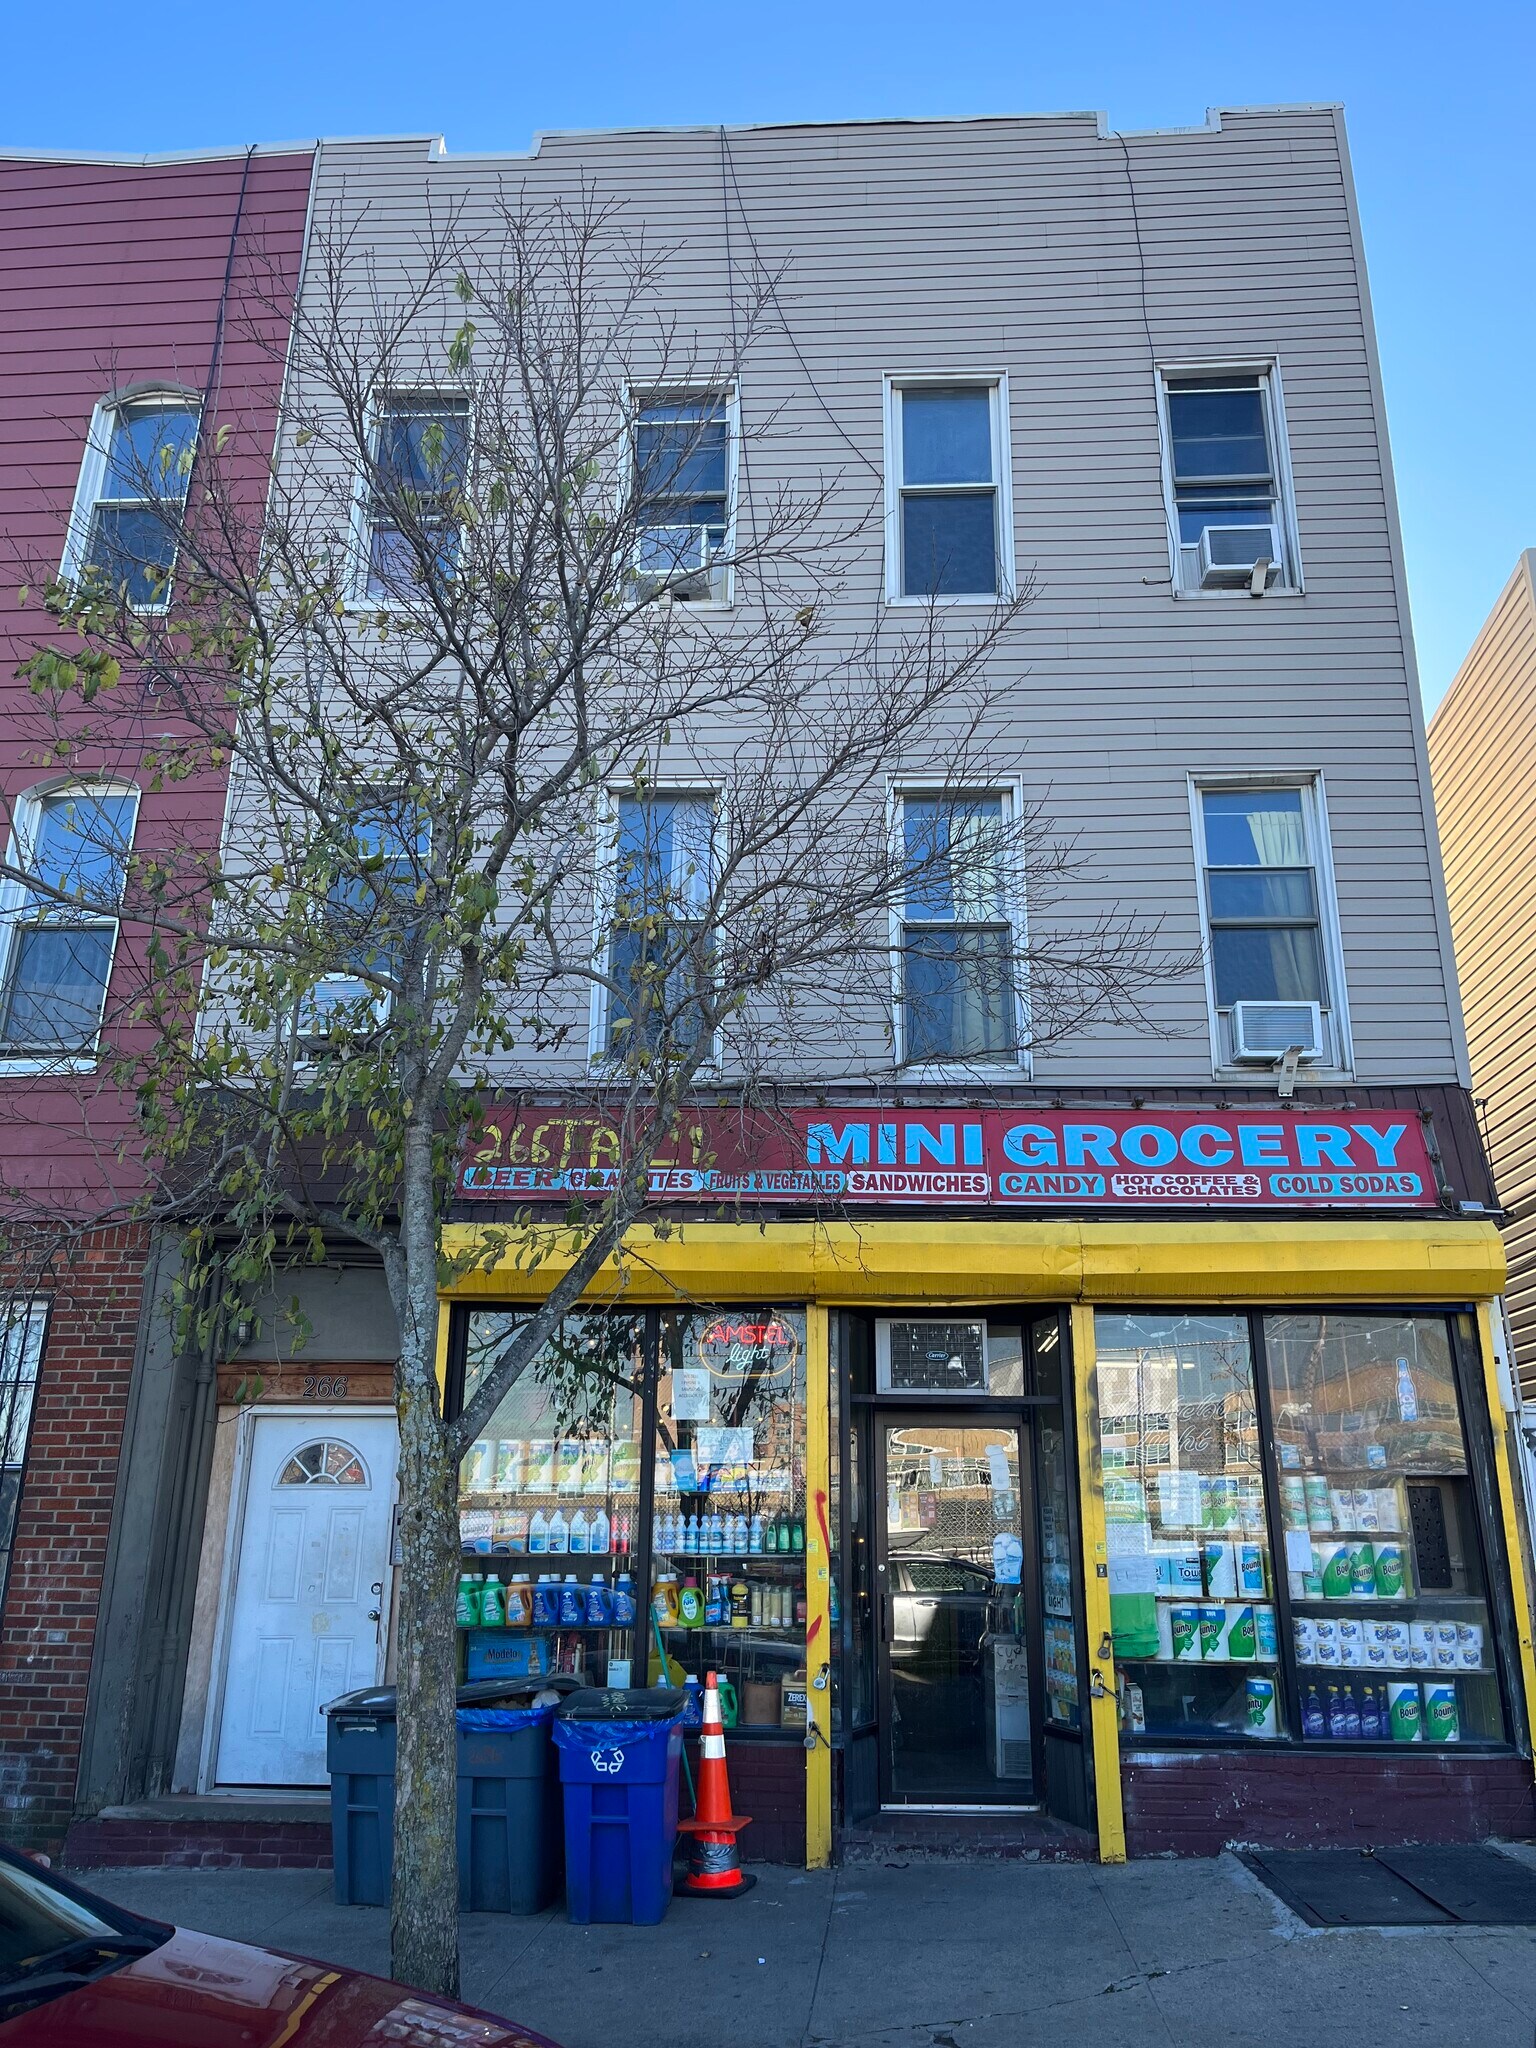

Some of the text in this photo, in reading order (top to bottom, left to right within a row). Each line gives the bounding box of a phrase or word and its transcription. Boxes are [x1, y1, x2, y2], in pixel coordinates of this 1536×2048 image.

[807, 1123, 1408, 1168] MINI GROCERY
[473, 1169, 553, 1187] BEER
[766, 1173, 841, 1191] VEGETABLES
[852, 1173, 986, 1193] SANDWICHES
[1004, 1175, 1099, 1194] CANDY
[1115, 1175, 1259, 1186] HOT COFFEE &
[1277, 1175, 1414, 1194] COLD SODAS
[1122, 1185, 1259, 1196] CHOCOLATES
[706, 1324, 789, 1345] AMSTEL
[725, 1342, 770, 1371] light
[303, 1375, 349, 1399] 266
[486, 1647, 519, 1661] Modelo
